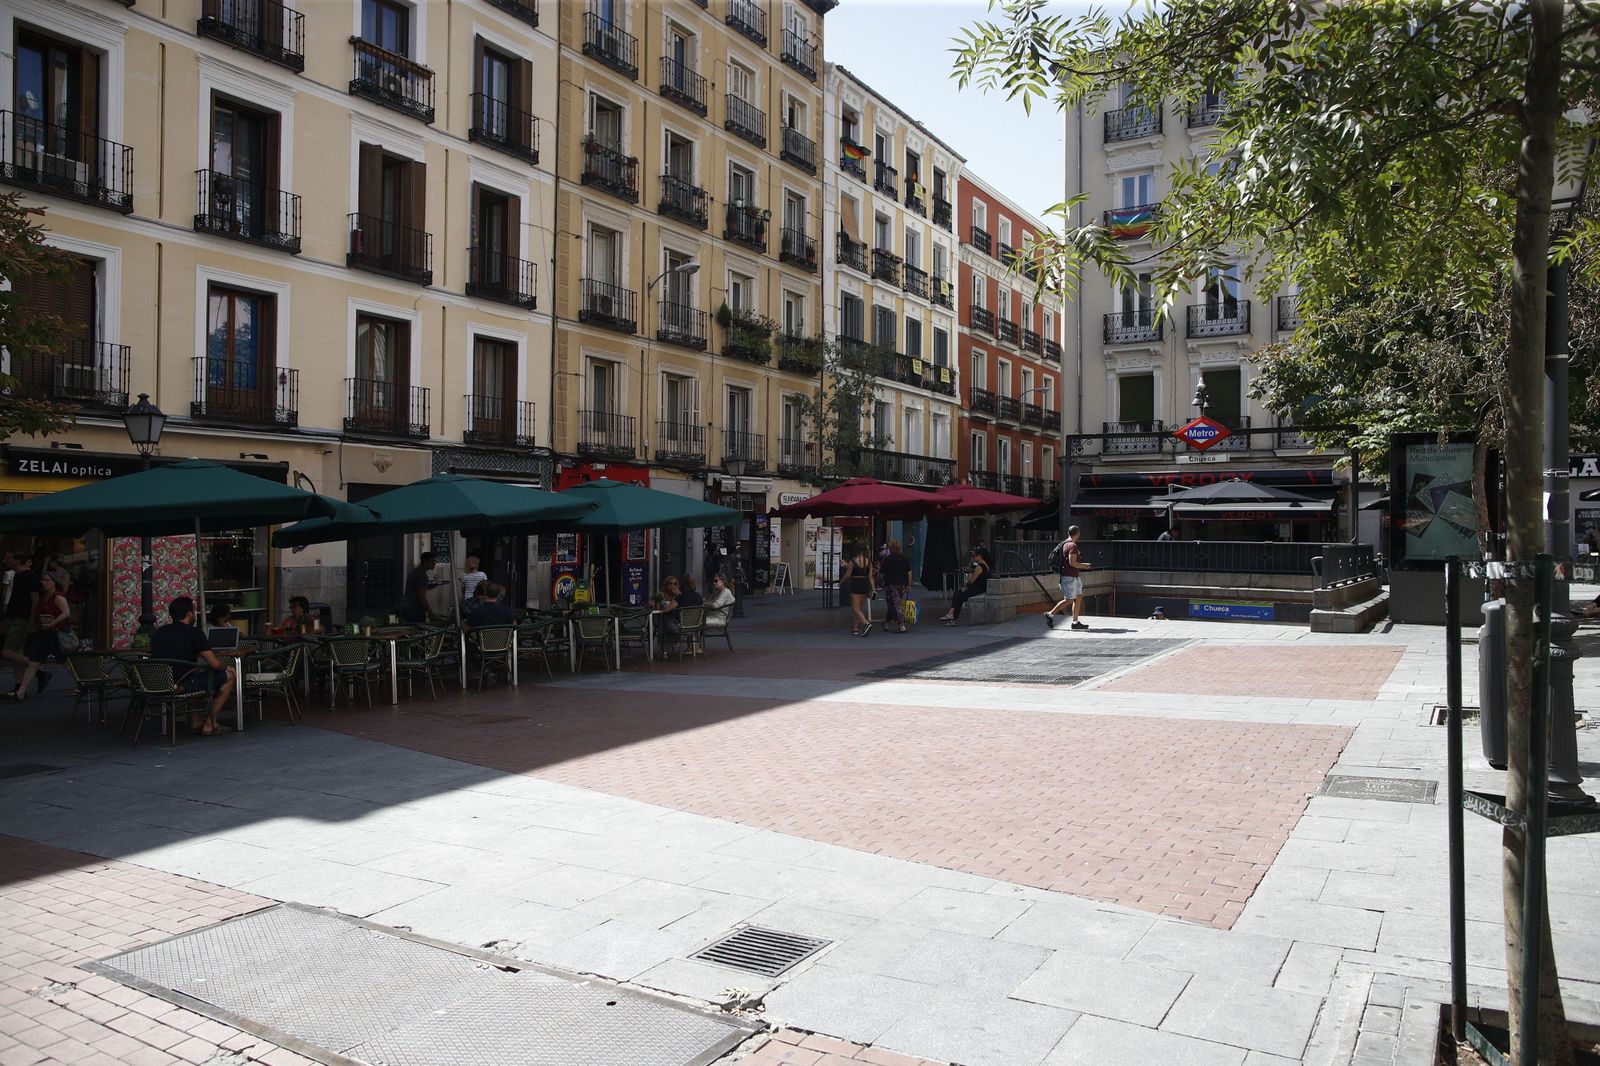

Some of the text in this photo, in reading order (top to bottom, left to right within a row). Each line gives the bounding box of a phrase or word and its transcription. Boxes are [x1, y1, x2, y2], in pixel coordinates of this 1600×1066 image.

[1189, 429, 1215, 438] Metro
[1409, 455, 1457, 463] Municipales
[18, 459, 112, 476] ZELAI optica
[1203, 604, 1230, 612] Chueca
